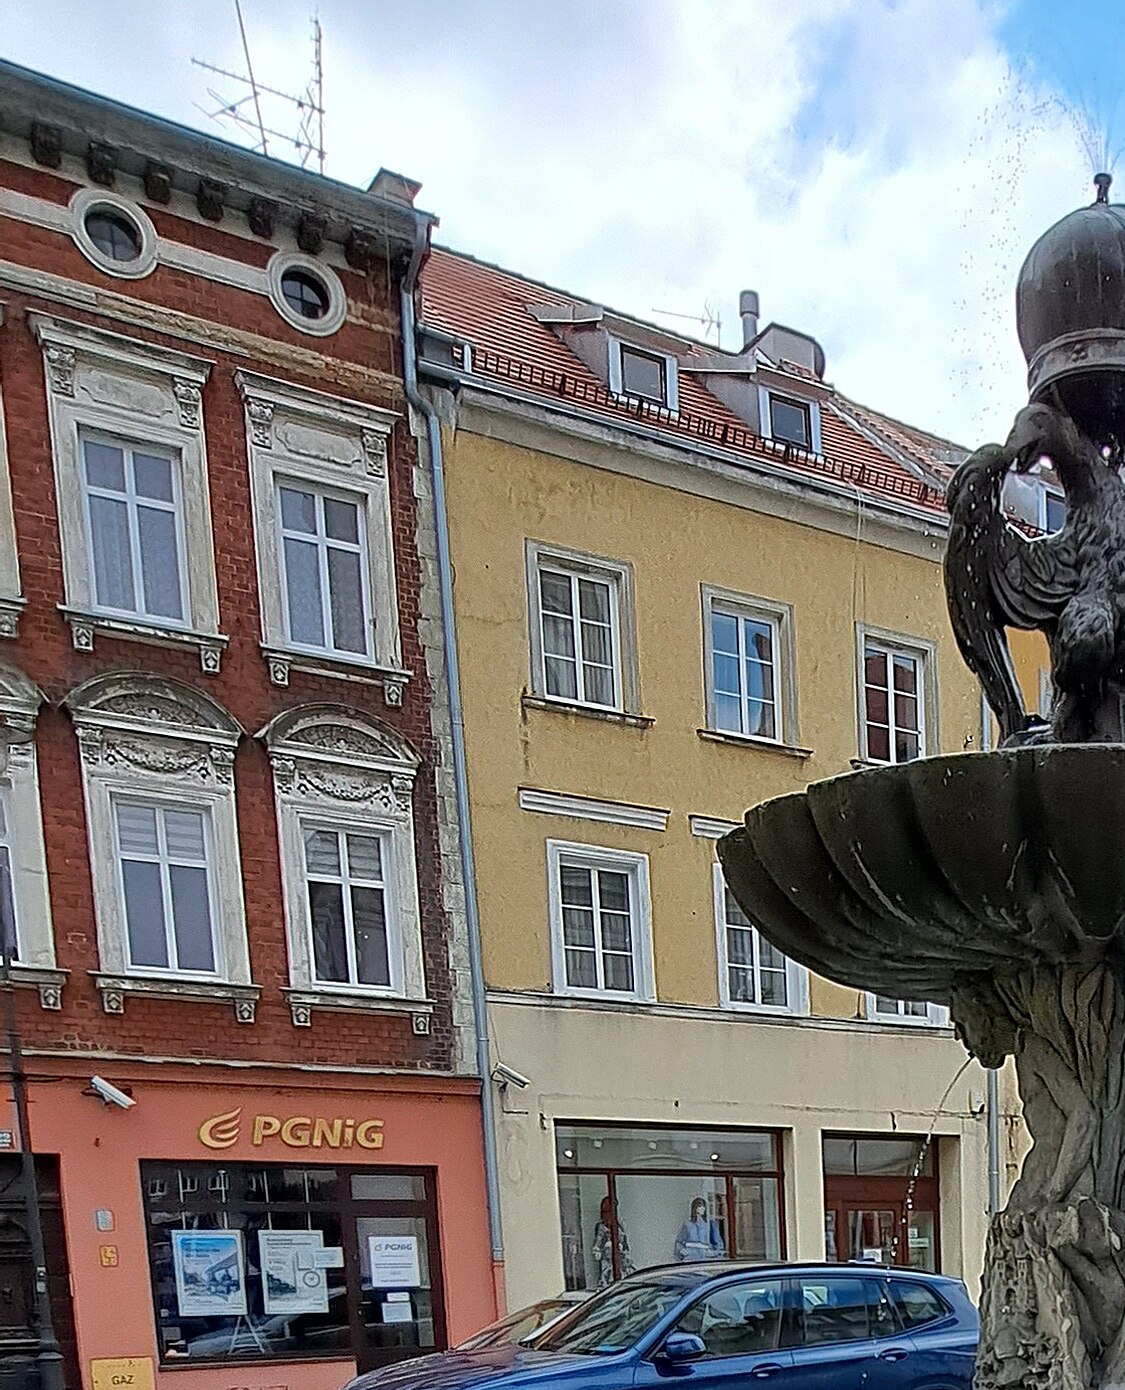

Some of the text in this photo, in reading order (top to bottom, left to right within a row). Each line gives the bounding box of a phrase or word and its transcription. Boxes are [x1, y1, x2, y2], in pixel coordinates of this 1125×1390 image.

[252, 1114, 385, 1149] PGNiG
[384, 1243, 413, 1251] PGNiG
[111, 1374, 135, 1386] GAZ
